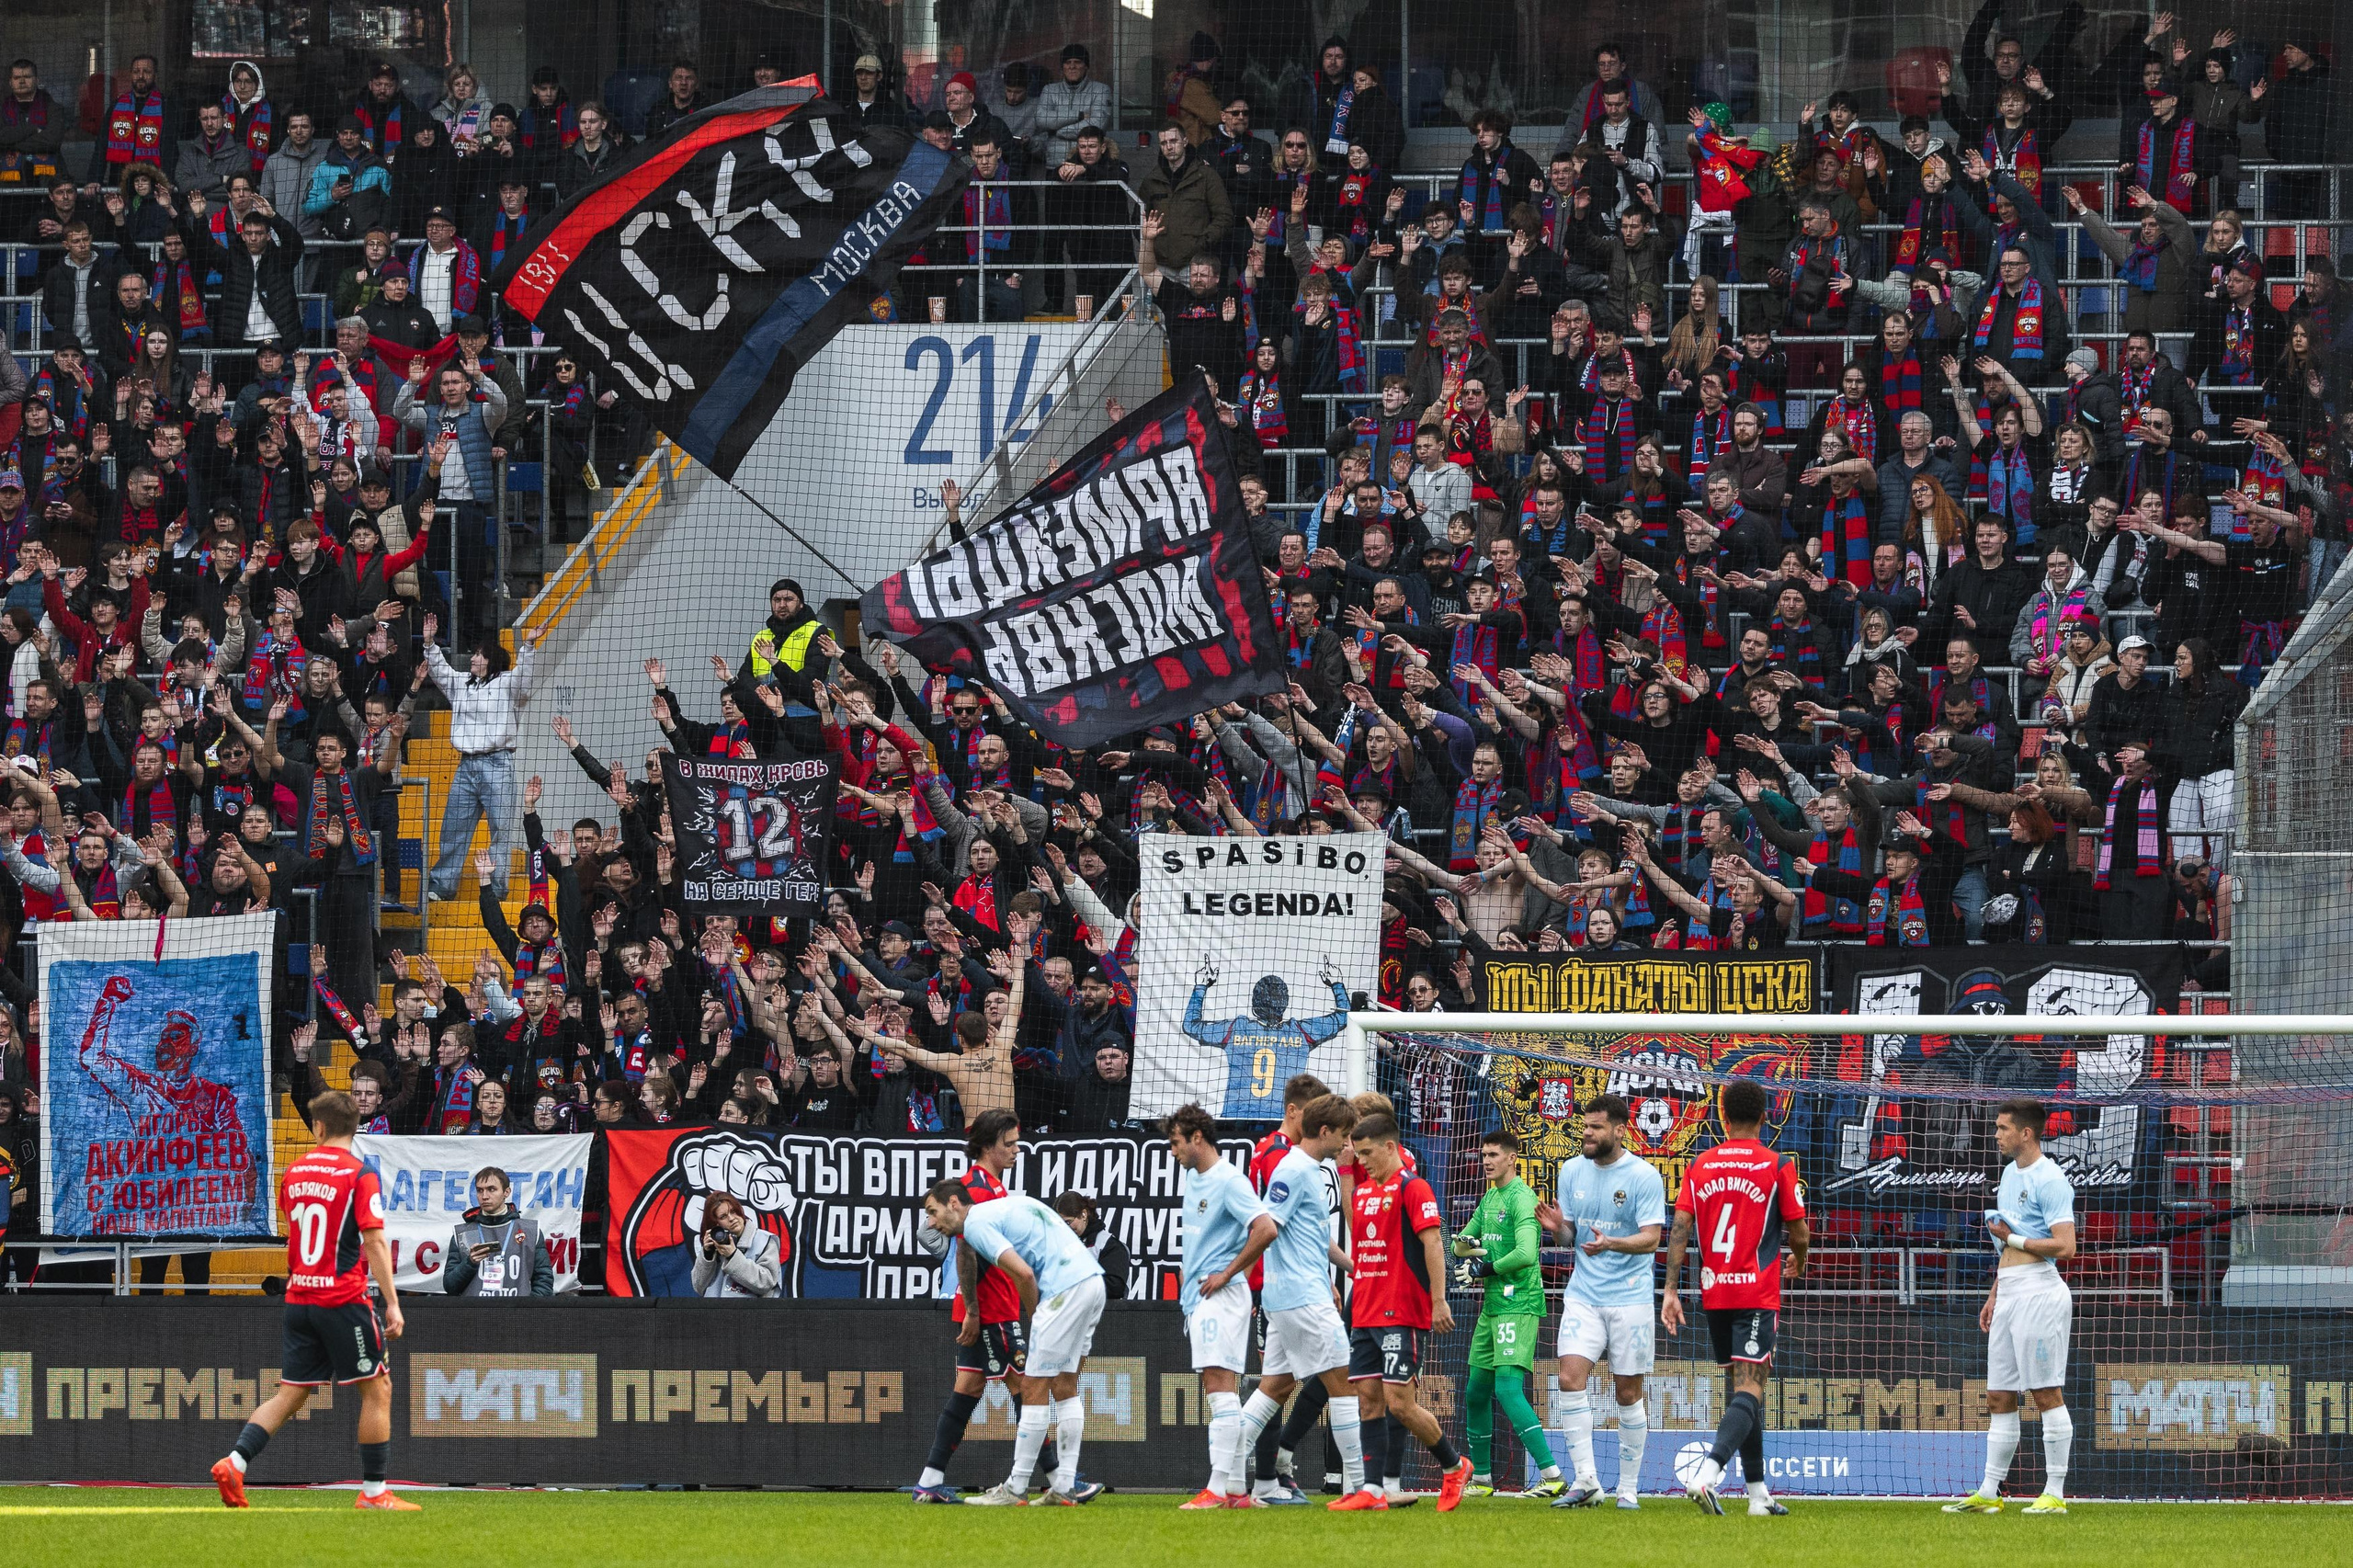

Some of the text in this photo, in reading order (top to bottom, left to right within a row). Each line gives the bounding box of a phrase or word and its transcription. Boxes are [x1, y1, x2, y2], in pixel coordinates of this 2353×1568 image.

[140, 127, 158, 136] ЦСКА
[809, 181, 922, 297] МОСКВА
[904, 335, 1053, 465] 214
[679, 759, 829, 783] В ЖИЛАХ КРОВЬ
[719, 796, 795, 861] 12
[684, 880, 709, 902] НА
[712, 880, 780, 902] СЕРДЦЕ
[1183, 892, 1354, 916] LEGENDA!
[1903, 921, 1925, 931] ЦСКА
[1485, 957, 1811, 1014] МЫ ФАНАТЫ ЦСКА
[540, 1066, 563, 1079] ЦСКА
[1250, 1049, 1277, 1098] 9
[85, 1131, 250, 1187] АКИНФЕЕВ
[790, 1145, 850, 1195] ТЫ
[1702, 1161, 1755, 1170] АЭРОФЛОТ
[86, 1173, 244, 1213] С ЮБИЛЕЕМ
[288, 1181, 336, 1203] ОБЛЯКОВ
[1727, 1176, 1767, 1204] ВИКТОР
[290, 1201, 328, 1267] 10
[1711, 1202, 1736, 1264] 4
[1199, 1317, 1219, 1344] 19
[1496, 1322, 1517, 1344] 35
[1383, 1352, 1398, 1375] 17
[424, 1369, 904, 1424] МАТЧ ПРЕМЬЕР
[2110, 1379, 2276, 1435] МАТЧ
